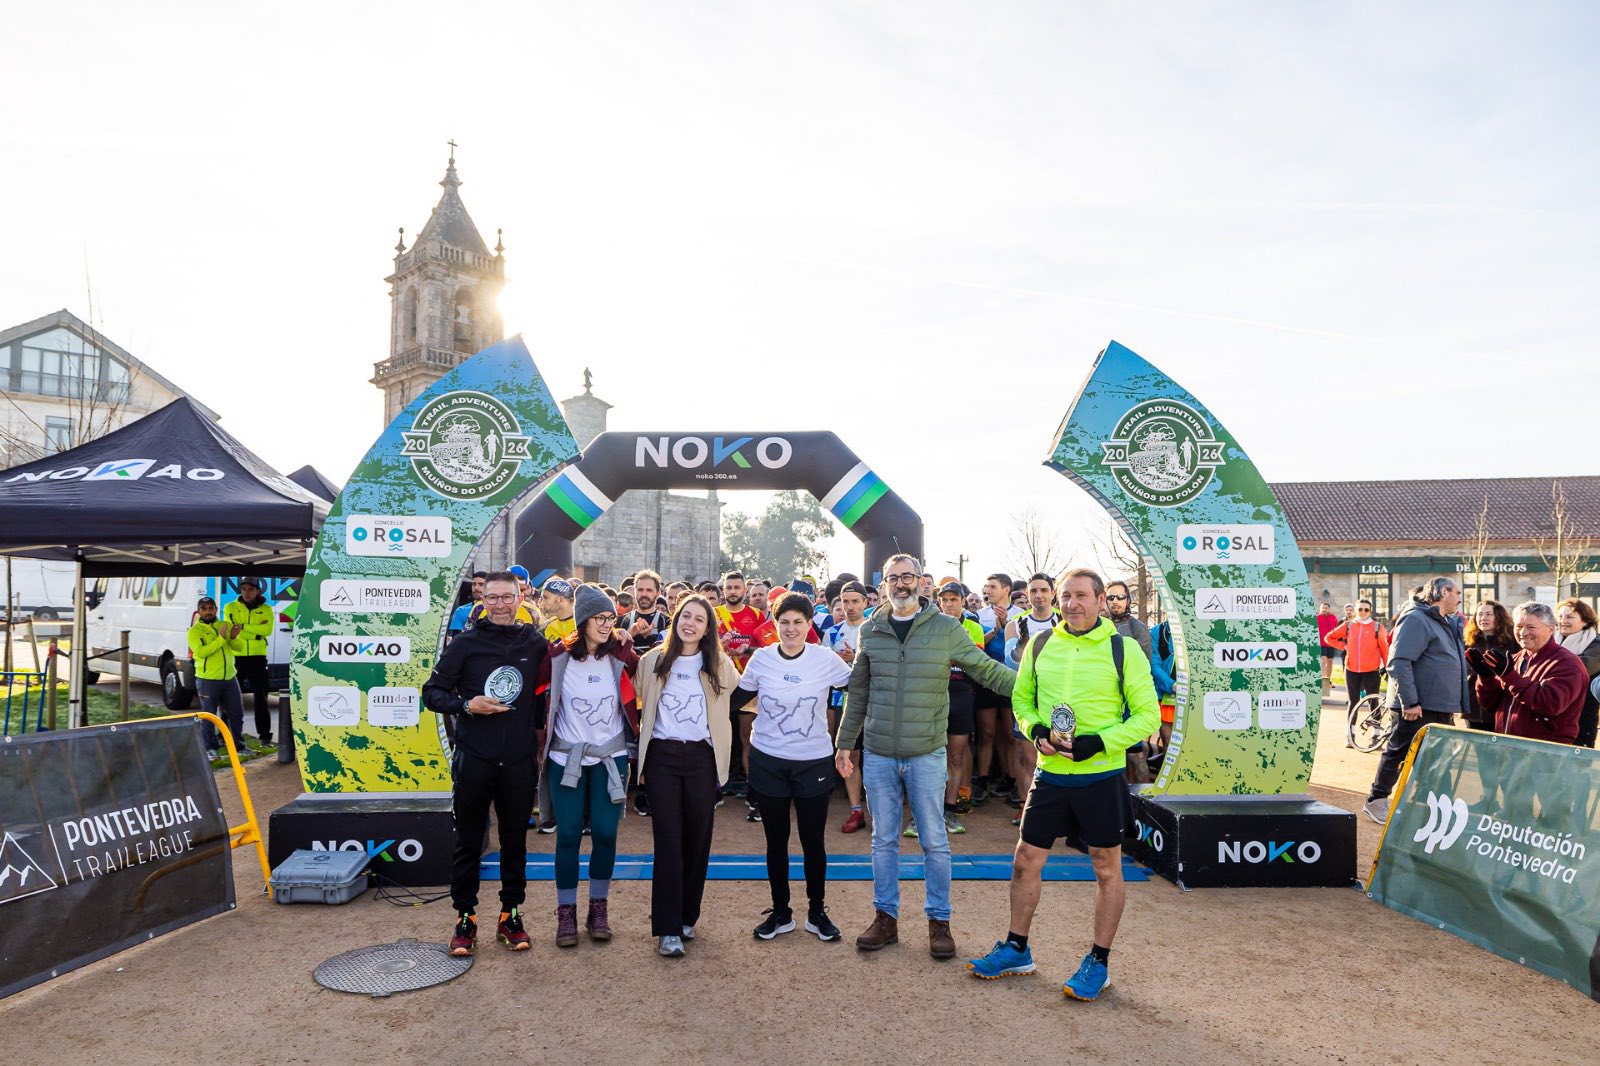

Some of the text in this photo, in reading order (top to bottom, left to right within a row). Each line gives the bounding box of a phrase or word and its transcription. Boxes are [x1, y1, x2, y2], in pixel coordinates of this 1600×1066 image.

[421, 397, 512, 431] TRAIL ADVENTURE
[1120, 405, 1206, 438] TRAIL ADVENTURE
[407, 439, 524, 454] 20 26
[635, 435, 793, 469] NOKO
[1106, 448, 1218, 460] 20 26
[4, 458, 226, 482] NOKAO
[478, 468, 510, 492] FOLÓN
[1175, 475, 1205, 499] FOLÓN
[373, 527, 445, 544] ROSAL
[1202, 536, 1268, 551] ROSAL
[1361, 563, 1527, 574] LIGA DE AMIGOS
[365, 587, 422, 598] PONTEVEDRA
[1236, 595, 1289, 604] PONTEVEDRA
[365, 599, 415, 607] TRAILEAGUE
[328, 642, 402, 656] NOKAO
[1222, 648, 1289, 662] NOKAO
[372, 694, 415, 704] amdor
[1263, 698, 1302, 707] amdor
[63, 795, 202, 851] PONTEVEDRA
[1476, 814, 1586, 860] Deputación
[73, 830, 194, 881] TRAILEAGUE
[1218, 840, 1322, 864] NOKO
[1465, 834, 1578, 884] Pontevedra
